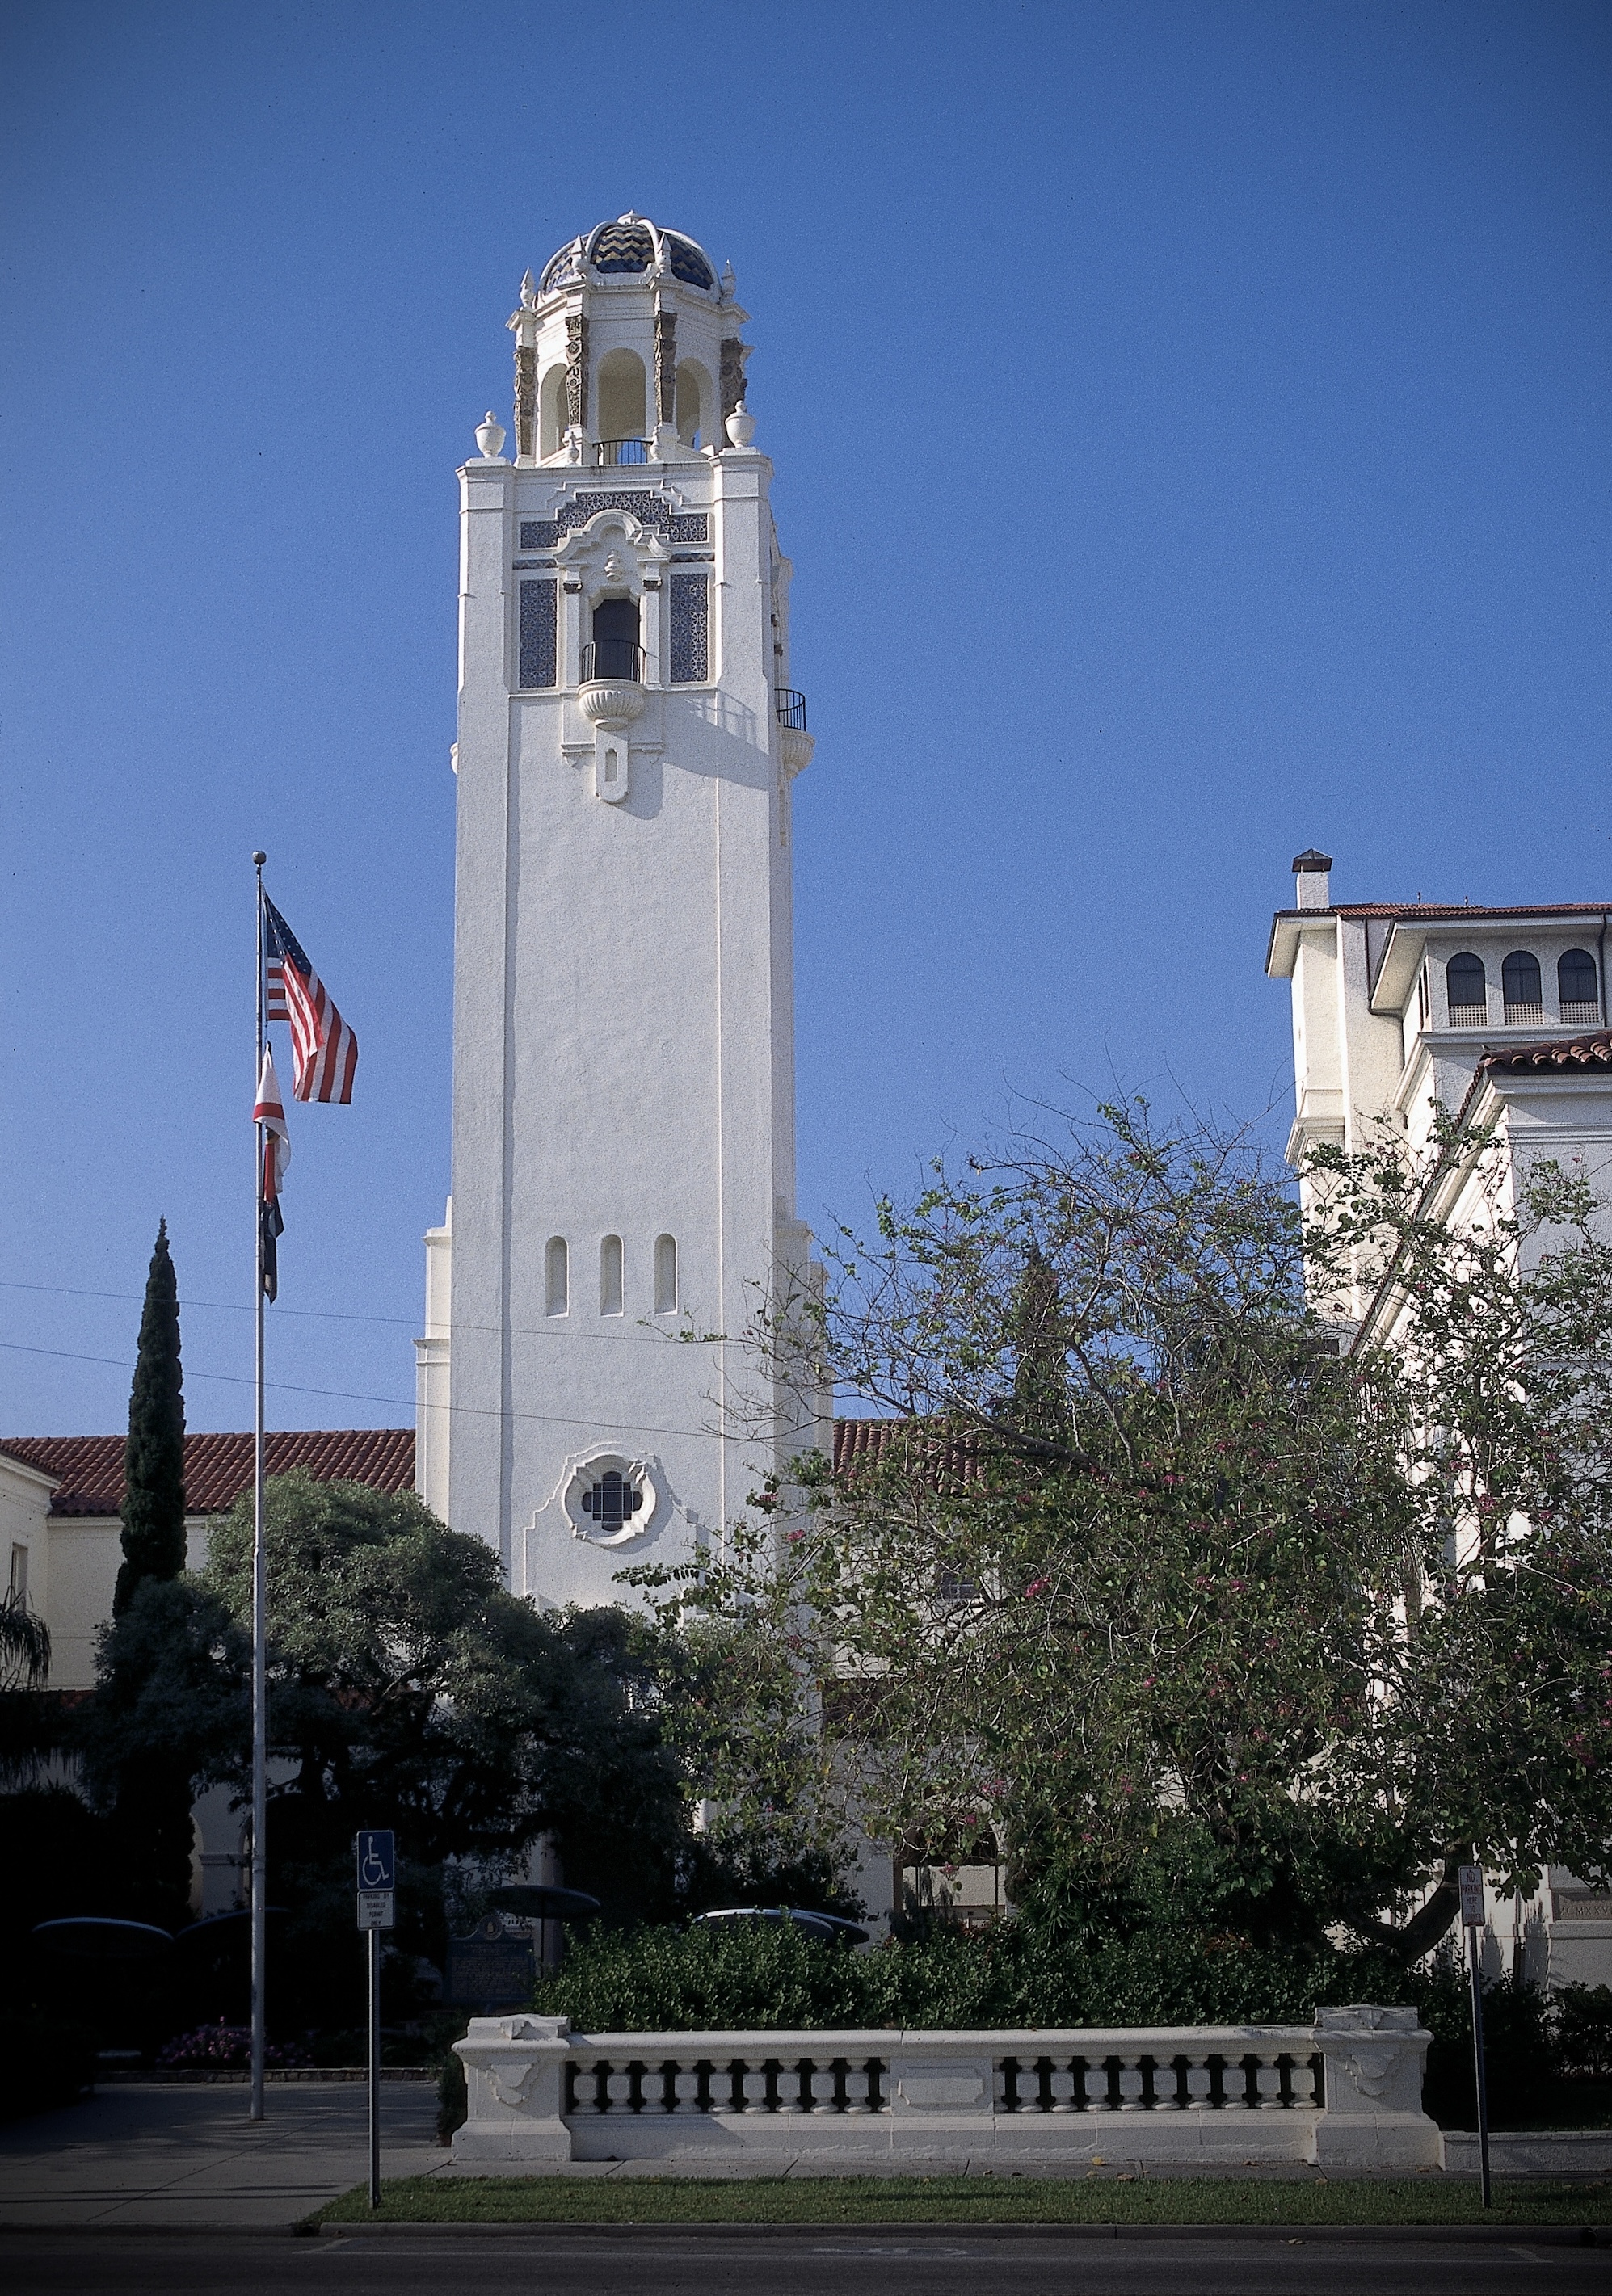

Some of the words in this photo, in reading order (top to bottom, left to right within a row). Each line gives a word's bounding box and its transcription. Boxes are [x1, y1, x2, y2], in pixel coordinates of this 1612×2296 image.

[1467, 1869, 1475, 1882] NO
[1461, 1884, 1482, 1894] PARKING
[1467, 1896, 1478, 1904] HERE
